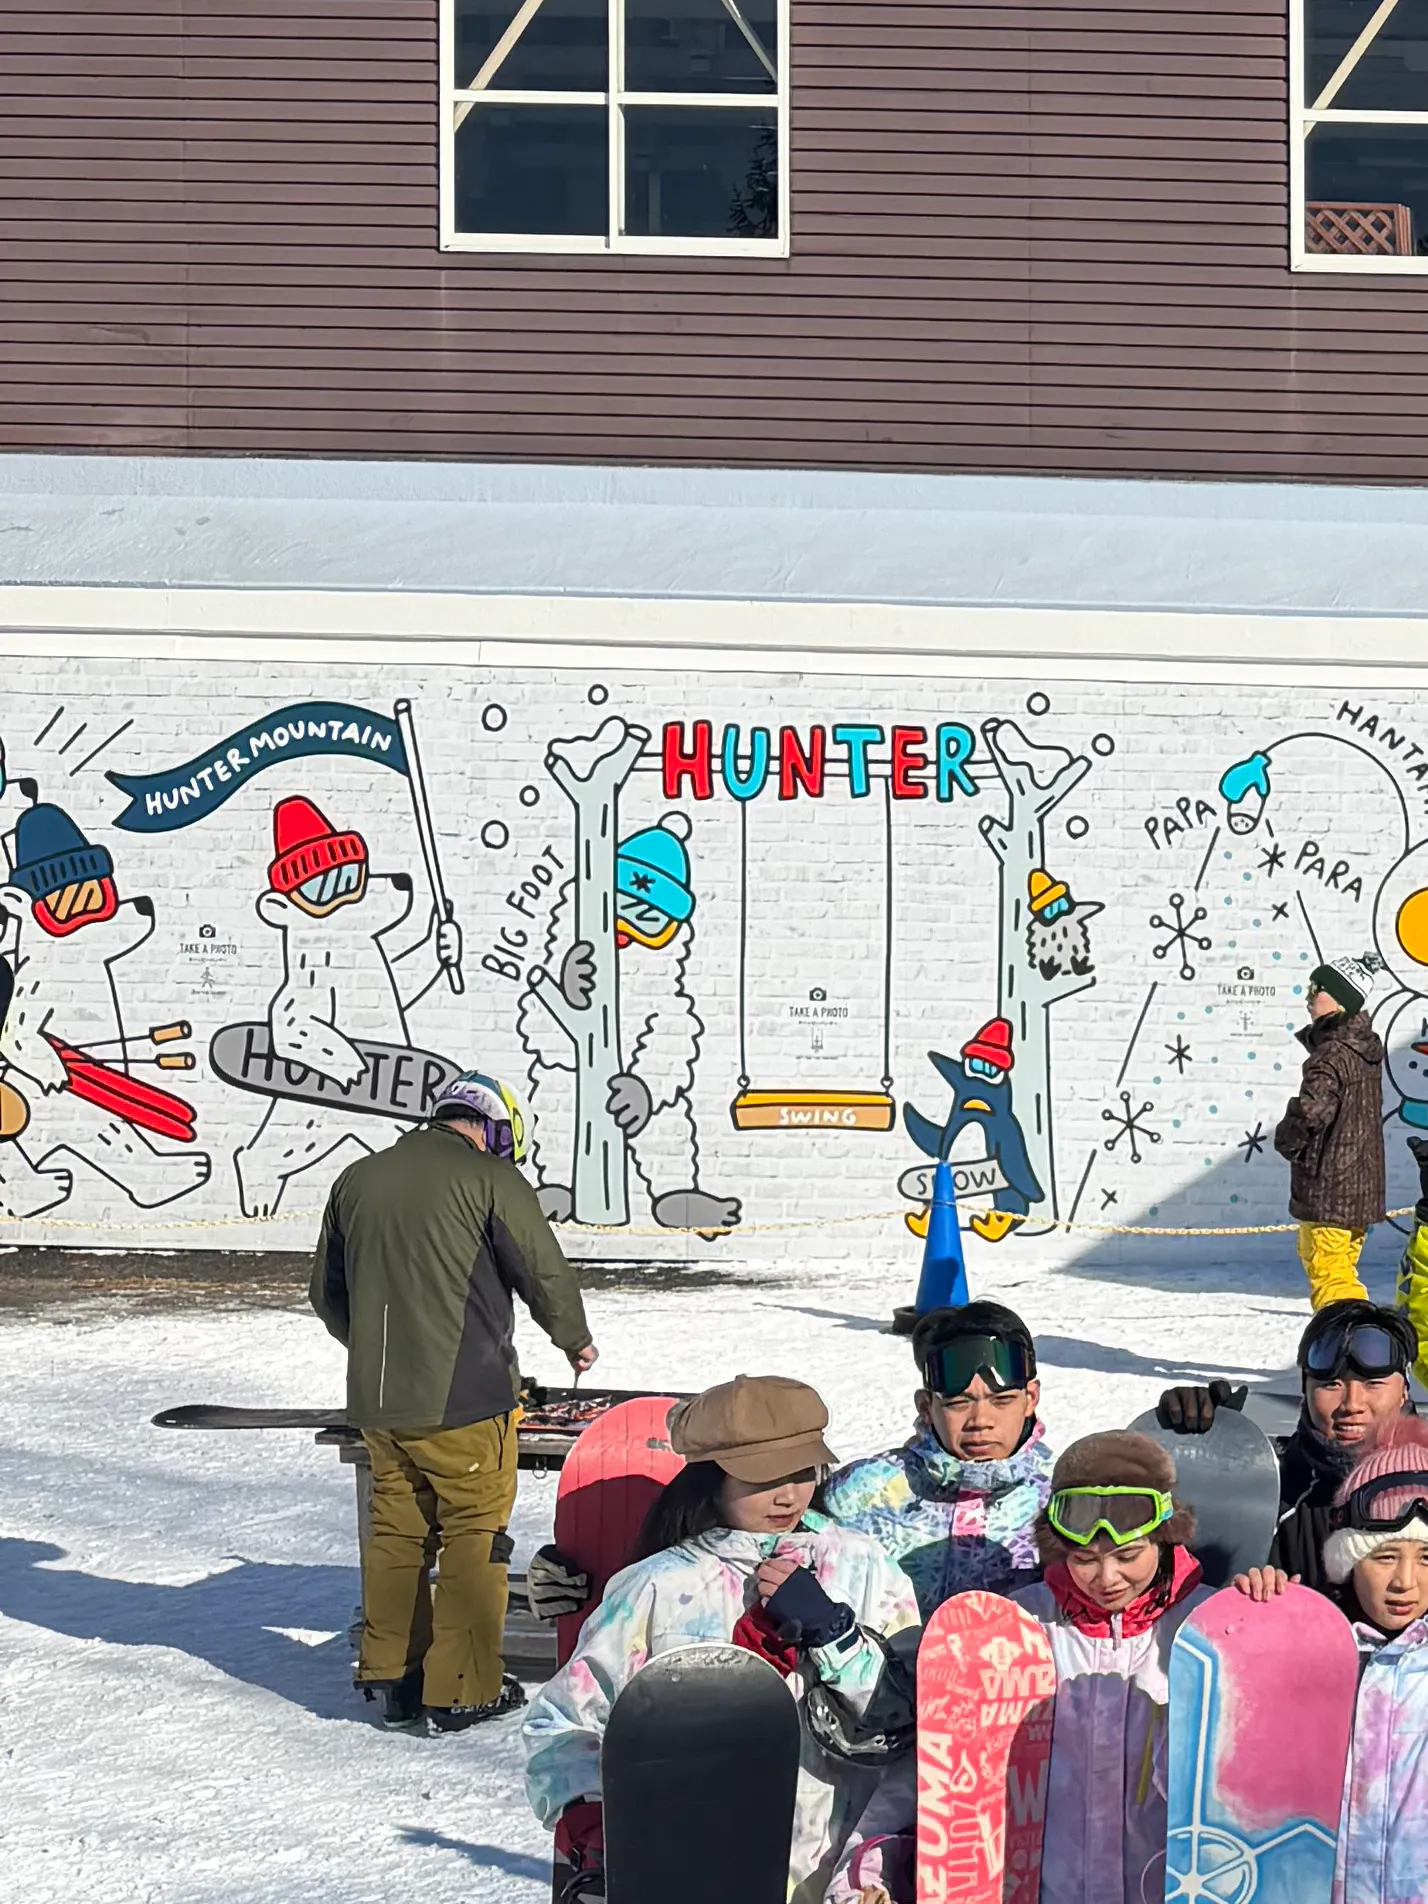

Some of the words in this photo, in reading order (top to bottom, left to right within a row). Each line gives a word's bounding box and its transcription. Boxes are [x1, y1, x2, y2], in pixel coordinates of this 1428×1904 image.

[145, 747, 250, 815] HUNTER
[248, 718, 393, 772] MOUNTAIN
[661, 719, 980, 802] HUNTER
[1144, 795, 1218, 849] PAPA
[1295, 840, 1364, 902] PARA
[481, 925, 527, 981] BIG
[506, 844, 565, 923] FOOT
[179, 942, 201, 954] TAKE
[1217, 983, 1239, 996] TAKE
[1249, 985, 1276, 997] PHOTO
[789, 1005, 810, 1017] TAKE
[820, 1006, 848, 1018] PHOTO
[779, 1107, 857, 1126] SWING
[916, 1167, 997, 1196] SOW
